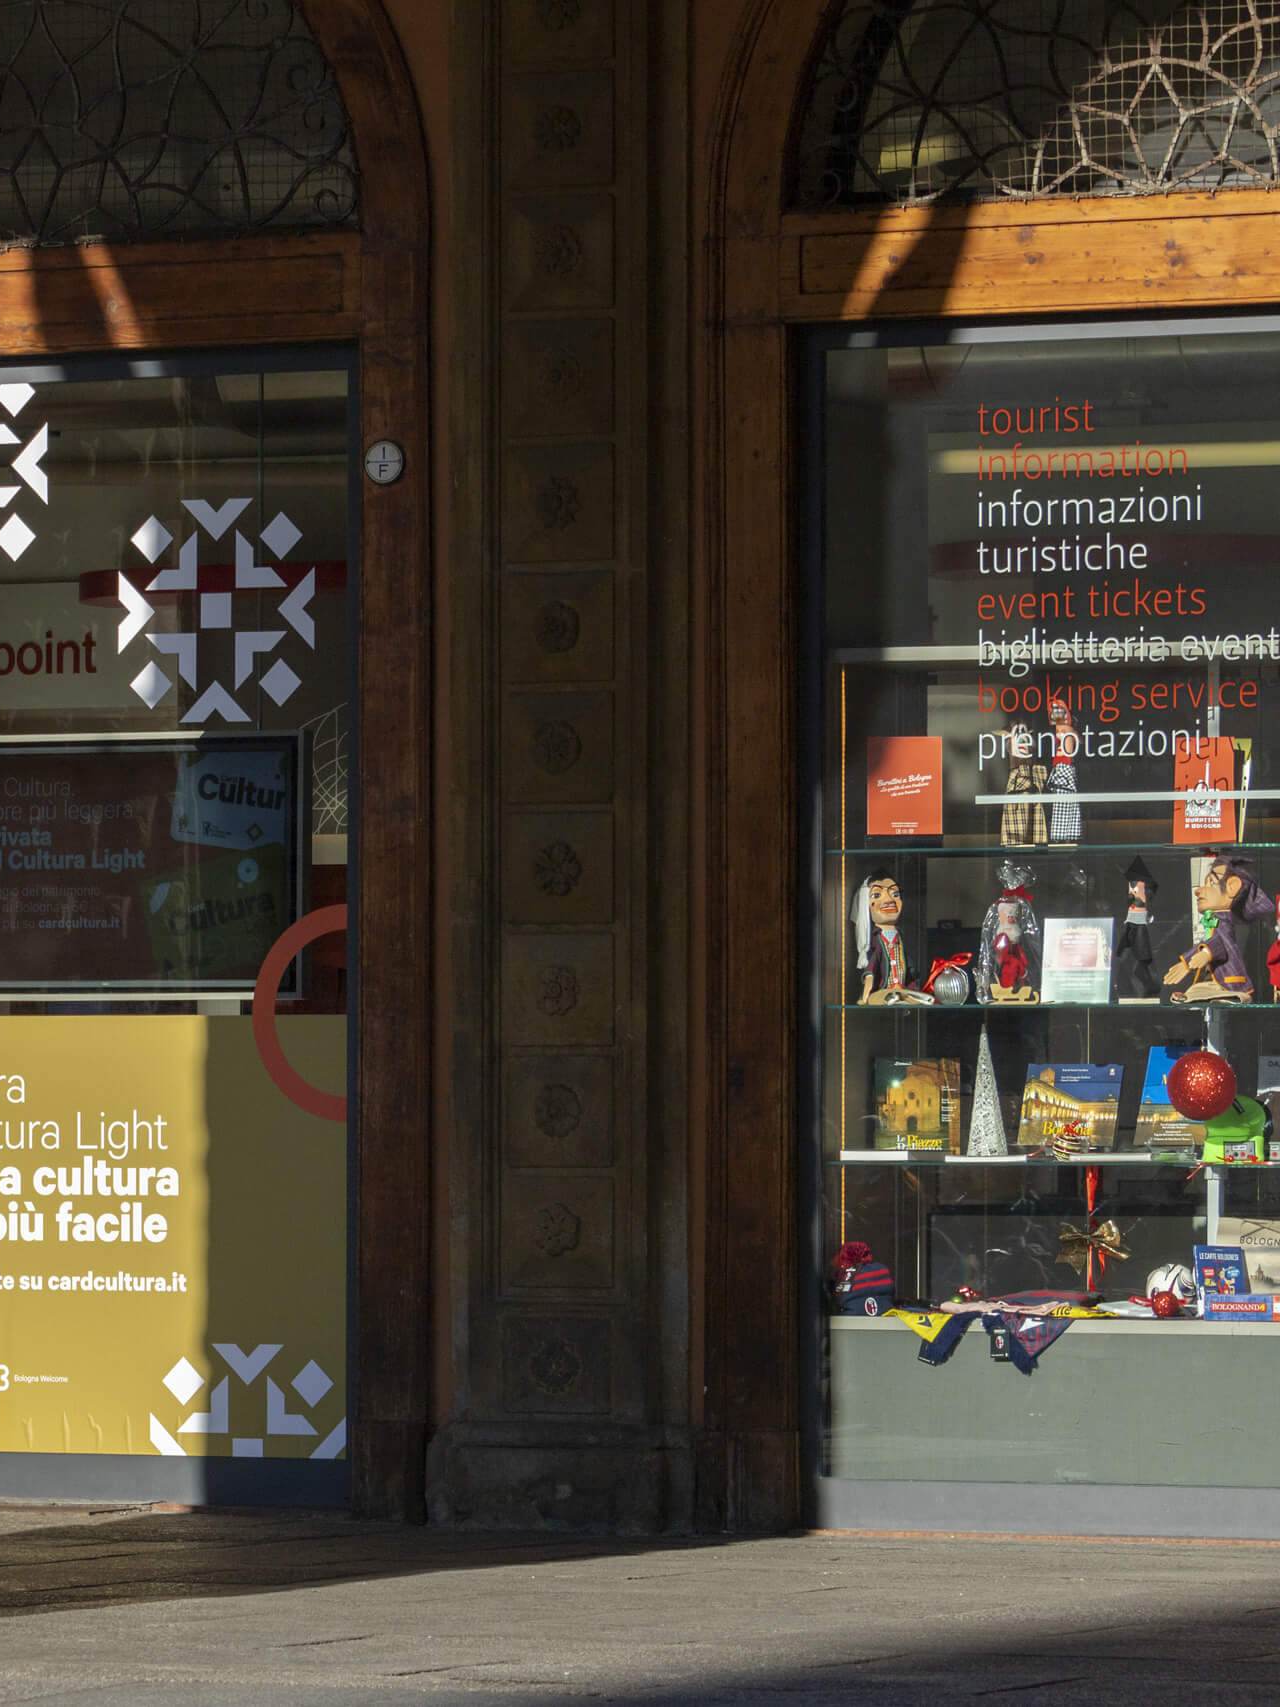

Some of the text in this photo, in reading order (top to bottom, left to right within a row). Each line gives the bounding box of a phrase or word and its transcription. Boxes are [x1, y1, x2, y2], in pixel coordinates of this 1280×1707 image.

[978, 396, 1094, 435] tourist
[379, 464, 389, 478] F
[978, 441, 1187, 481] information
[978, 485, 1203, 528] informazioni
[977, 532, 1148, 574] turistiche
[977, 579, 1207, 620] event tickets
[978, 626, 1167, 678] biglietteria
[978, 672, 1257, 722] booking service
[978, 719, 1202, 771] prenotazioni
[29, 801, 57, 823] più
[8, 849, 84, 871] Cultura
[92, 849, 145, 873] Light
[38, 916, 121, 929] cardcultura.it
[76, 1109, 169, 1160] Light
[906, 1134, 943, 1148] Piazze
[32, 1155, 180, 1198] cultura
[56, 1201, 169, 1243] facile
[19, 1275, 44, 1291] su
[48, 1271, 188, 1293] cardcultura.it
[14, 1374, 39, 1384] Bologna
[40, 1375, 69, 1383] Welcome
